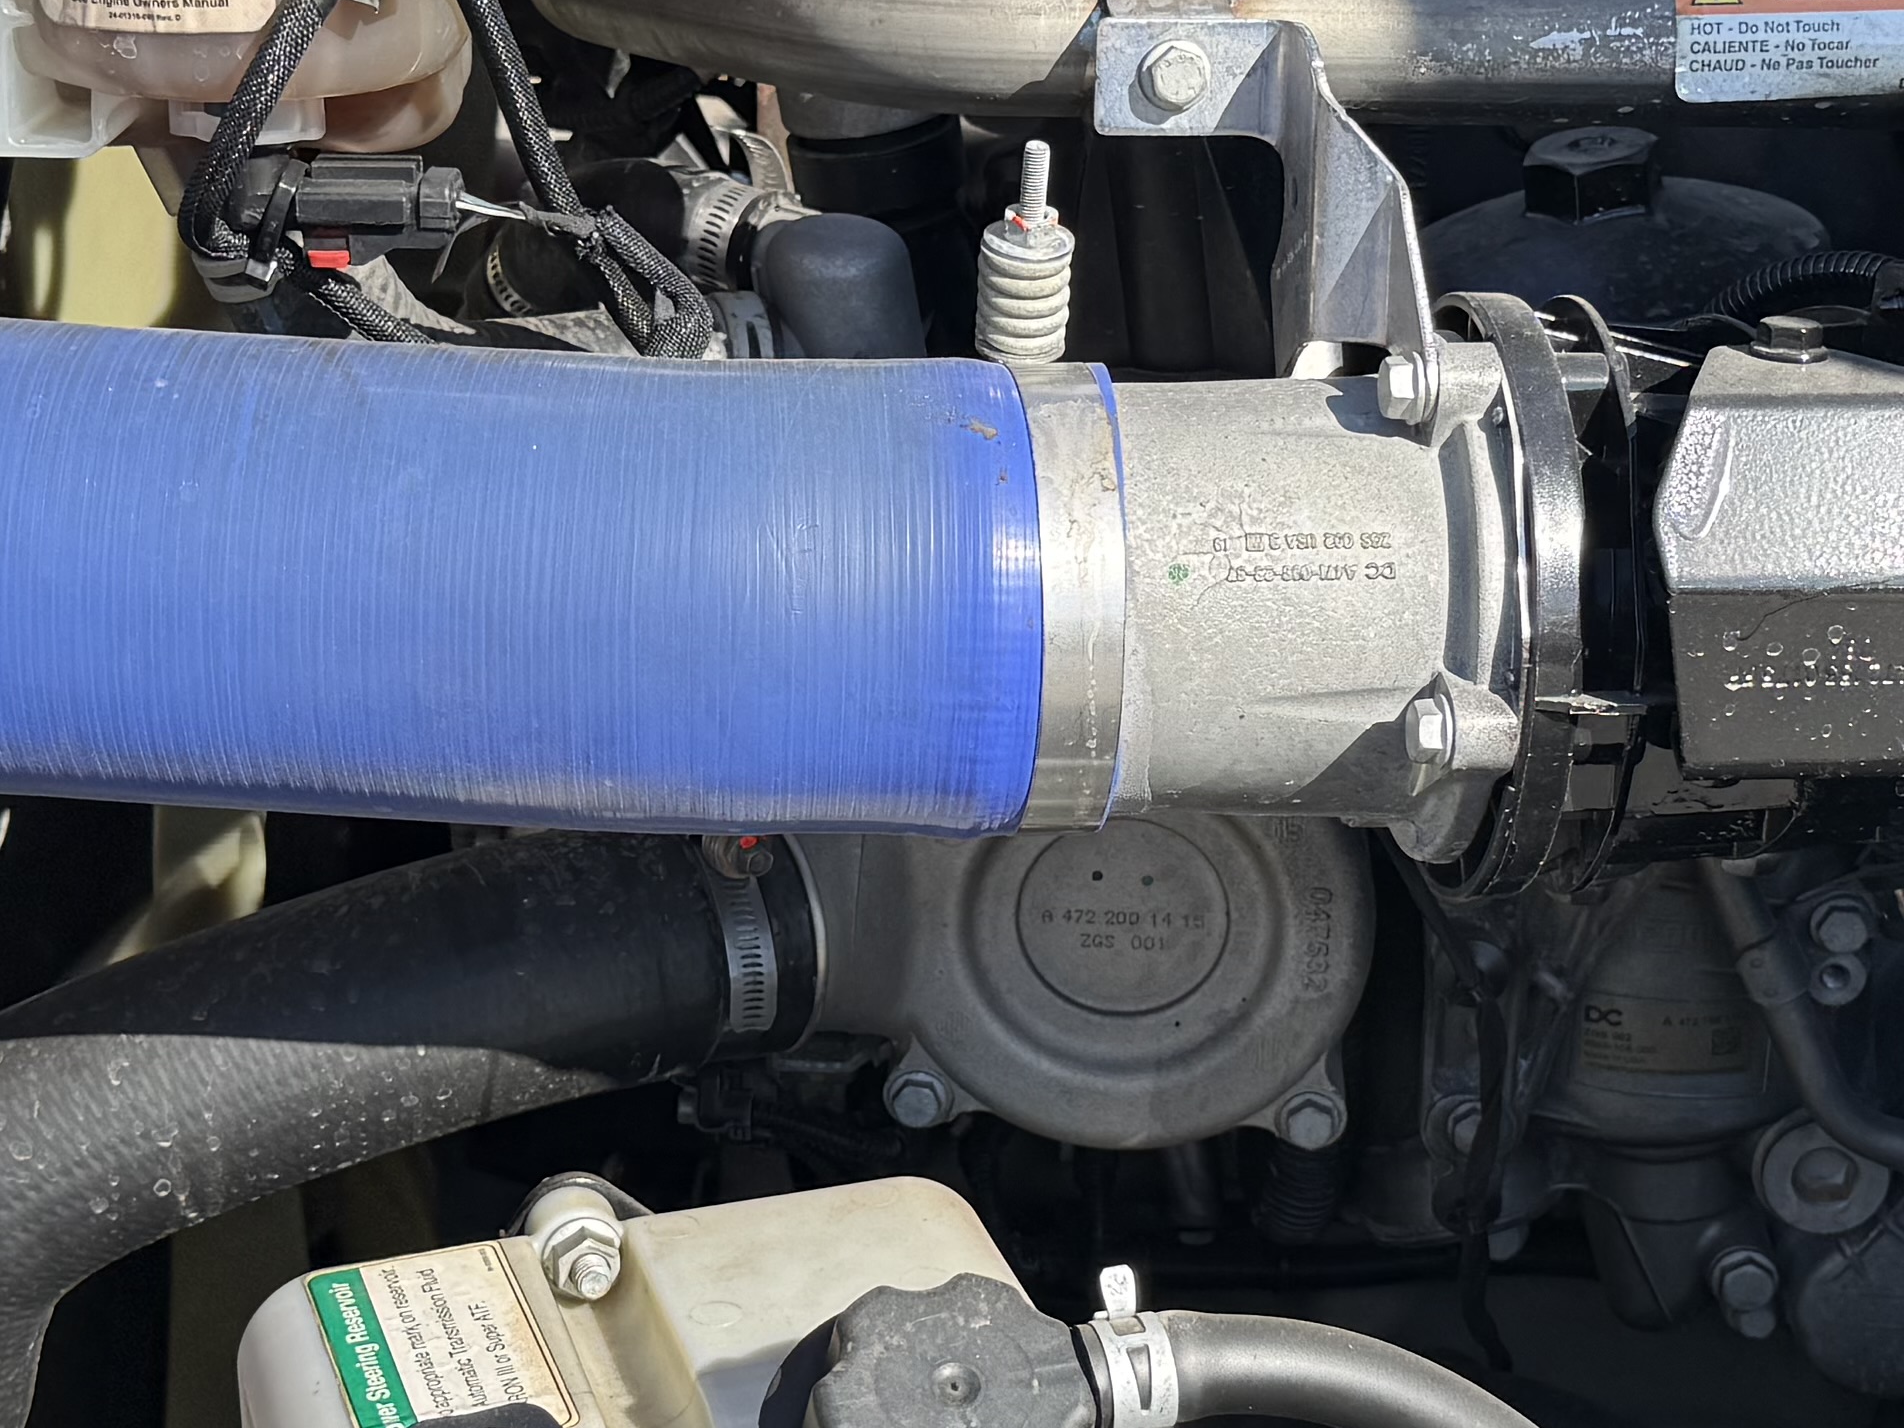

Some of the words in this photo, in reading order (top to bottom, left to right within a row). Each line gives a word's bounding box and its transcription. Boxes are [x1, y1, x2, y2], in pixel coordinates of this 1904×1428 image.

[1690, 22, 1723, 36] HOT
[1738, 21, 1759, 35] Do
[1764, 20, 1791, 34] Not
[1795, 19, 1841, 33] Touch
[1690, 39, 1770, 55] CALIENTE
[1784, 39, 1806, 53] No
[1810, 37, 1851, 52] Tocar
[1689, 58, 1746, 73] CHAUD
[1786, 57, 1813, 70] Pas
[1818, 55, 1880, 70] Toucher
[1041, 910, 1054, 923] A
[1062, 909, 1096, 924] 472
[1105, 910, 1139, 926] 200
[1150, 912, 1173, 928] 14
[1080, 934, 1114, 949] ZGS
[1131, 935, 1165, 950] 001
[1585, 1005, 1623, 1027] DC
[382, 1266, 409, 1307] reservoir.
[417, 1268, 440, 1293] Fluid
[329, 1282, 369, 1344] Reservoir
[399, 1308, 414, 1326] on
[430, 1292, 467, 1358] Transmission
[401, 1322, 427, 1351] mark
[483, 1322, 505, 1354] Super
[495, 1354, 511, 1364] or
[355, 1343, 391, 1402] Steering
[415, 1351, 451, 1416] appropriate
[458, 1358, 490, 1408] Automatic
